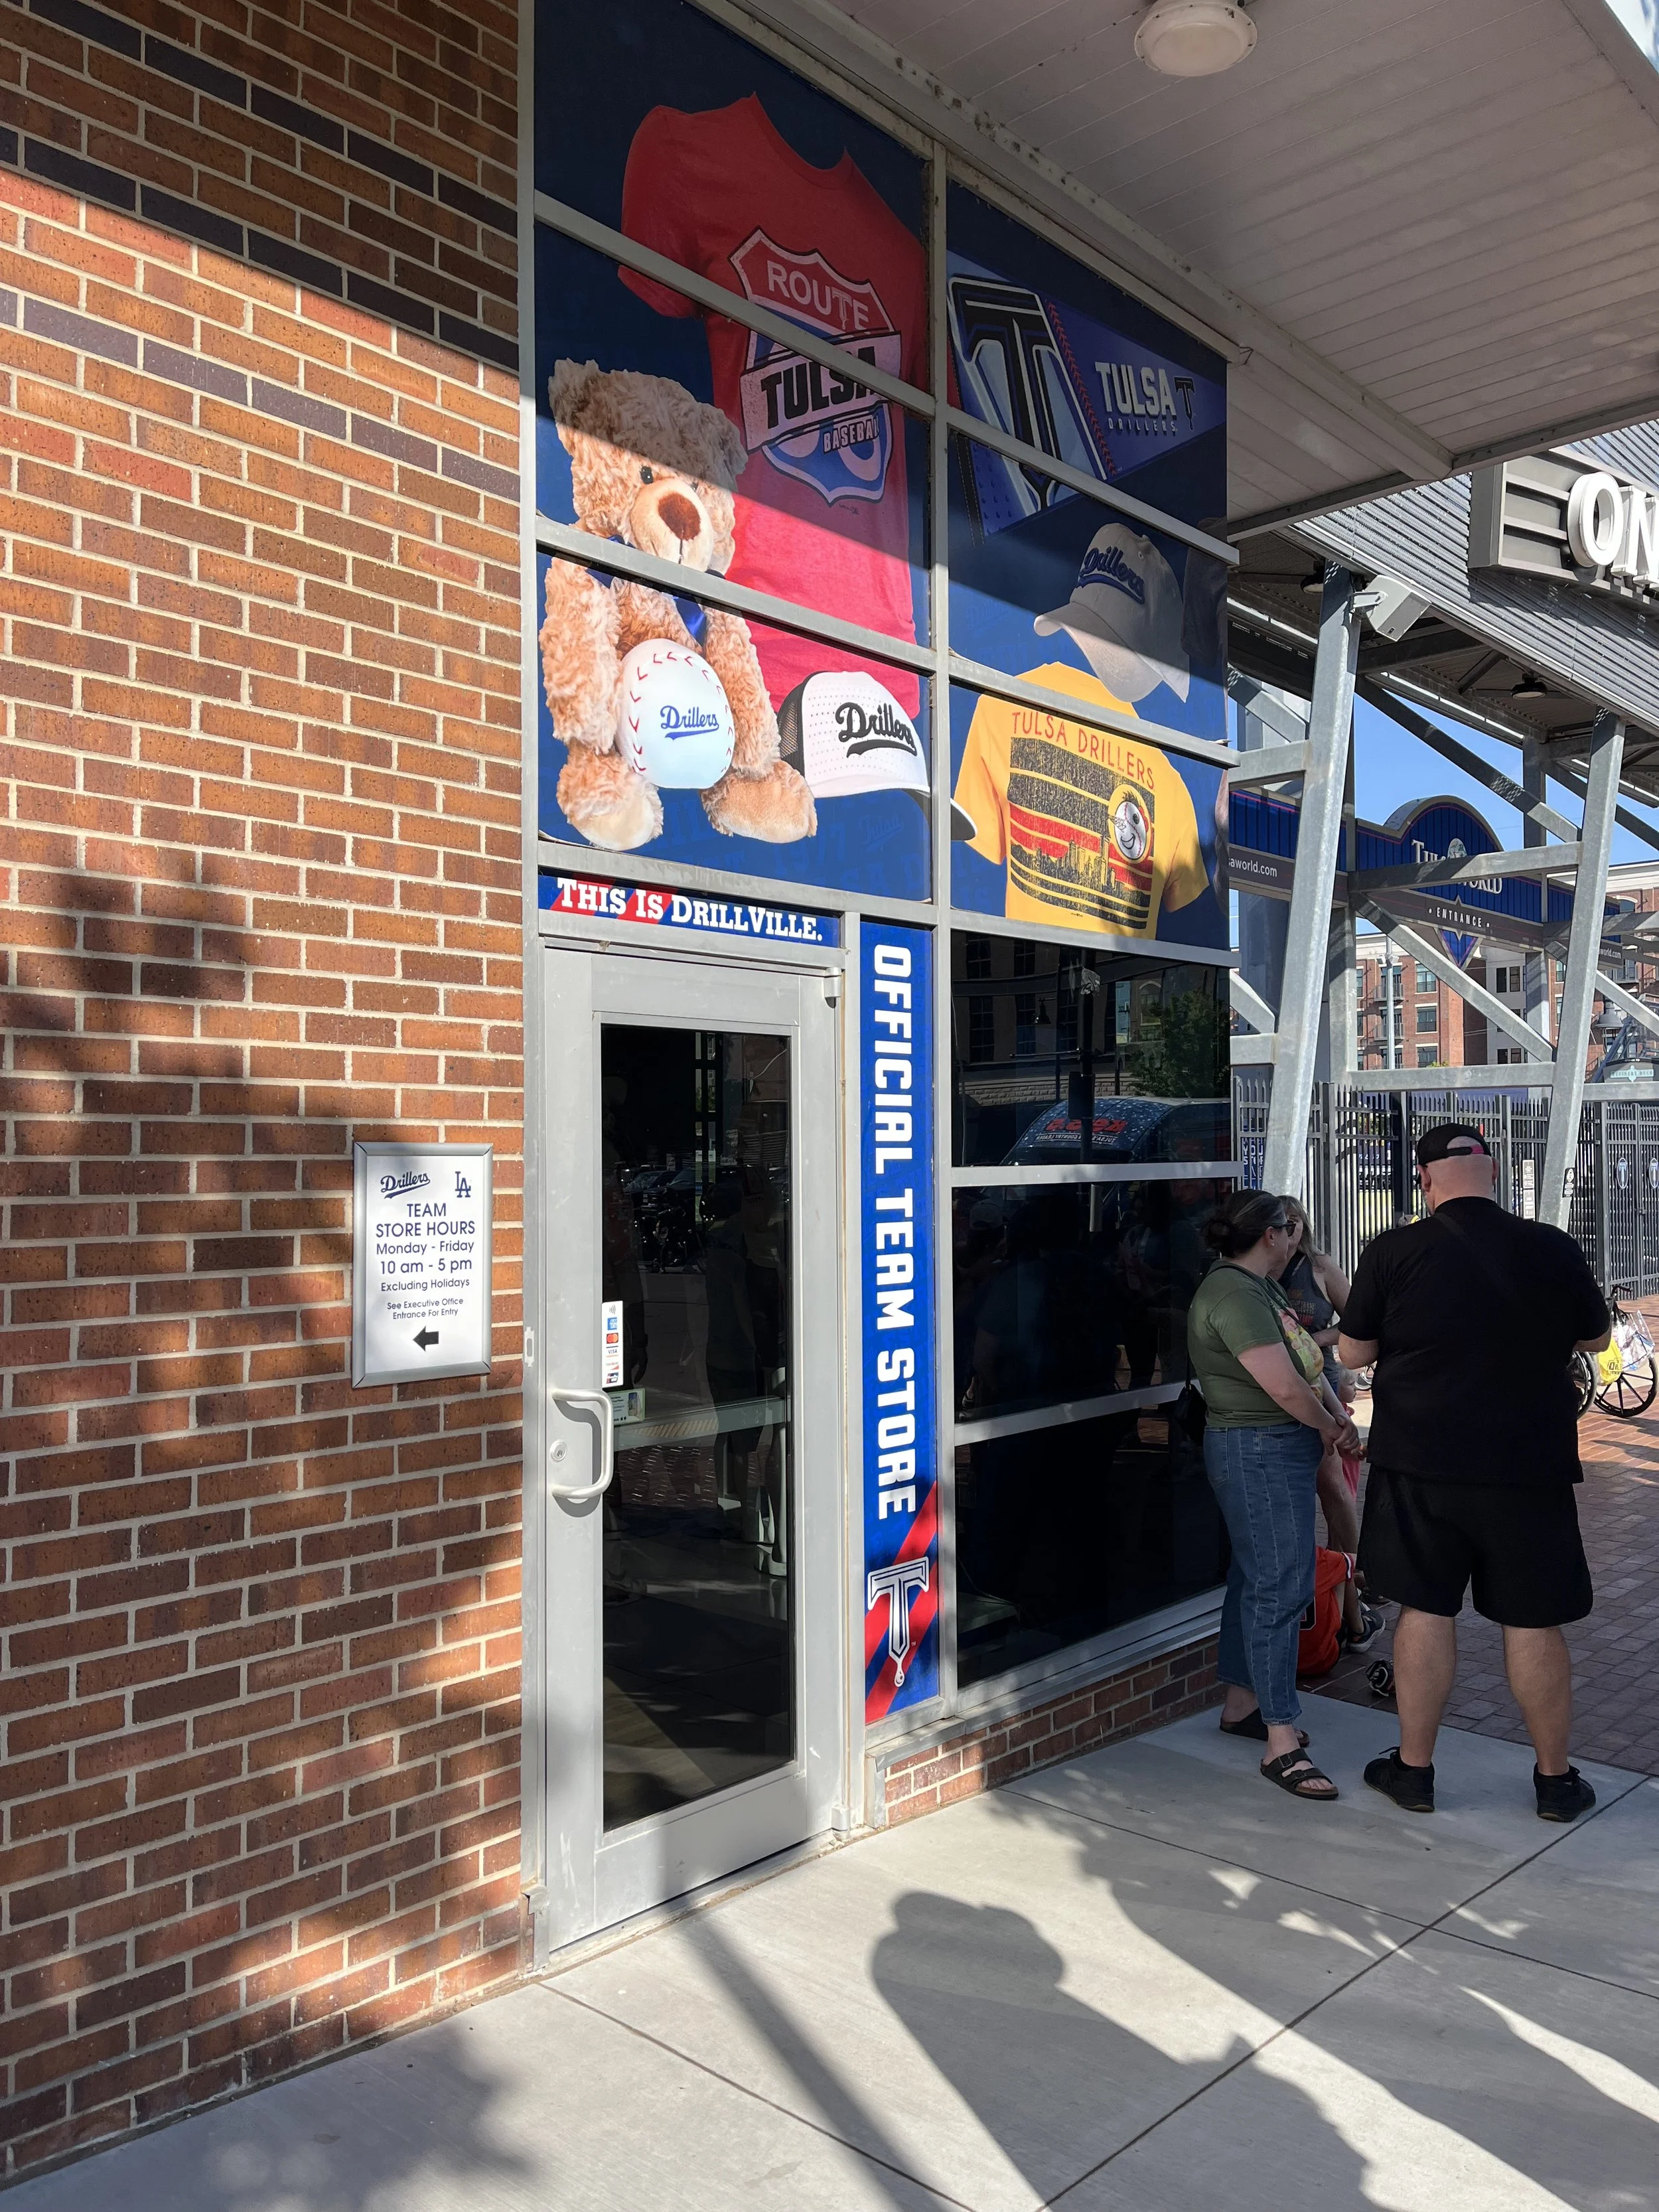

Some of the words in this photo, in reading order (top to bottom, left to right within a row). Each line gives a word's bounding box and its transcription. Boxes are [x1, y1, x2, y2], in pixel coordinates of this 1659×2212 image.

[766, 259, 869, 331] ROUTE
[1095, 361, 1177, 416] TULSA
[1108, 417, 1177, 432] DRILLERS
[660, 705, 719, 730] Drillers
[835, 702, 918, 748] Drillers
[1012, 711, 1068, 747] TULSA
[1078, 728, 1155, 790] DRILLERS
[557, 877, 626, 915] THIS
[635, 888, 664, 920] IS
[1437, 907, 1482, 927] ENTRANCE
[874, 944, 912, 1174] OFFICIAL
[380, 1171, 431, 1193] Drillers
[455, 1171, 471, 1198] LA
[407, 1203, 446, 1217] TEAM
[376, 1222, 421, 1238] STORE
[427, 1220, 475, 1236] HOURS
[376, 1242, 427, 1255] Monday
[440, 1240, 474, 1253] Friday
[875, 1188, 914, 1331] TEAM
[381, 1260, 396, 1274] 10
[400, 1262, 423, 1273] am
[438, 1258, 446, 1271] 5
[451, 1259, 472, 1274] pm
[381, 1280, 428, 1291] Excluding
[431, 1278, 470, 1288] Holidays
[403, 1299, 440, 1308] Executive
[877, 1347, 916, 1520] STORE
